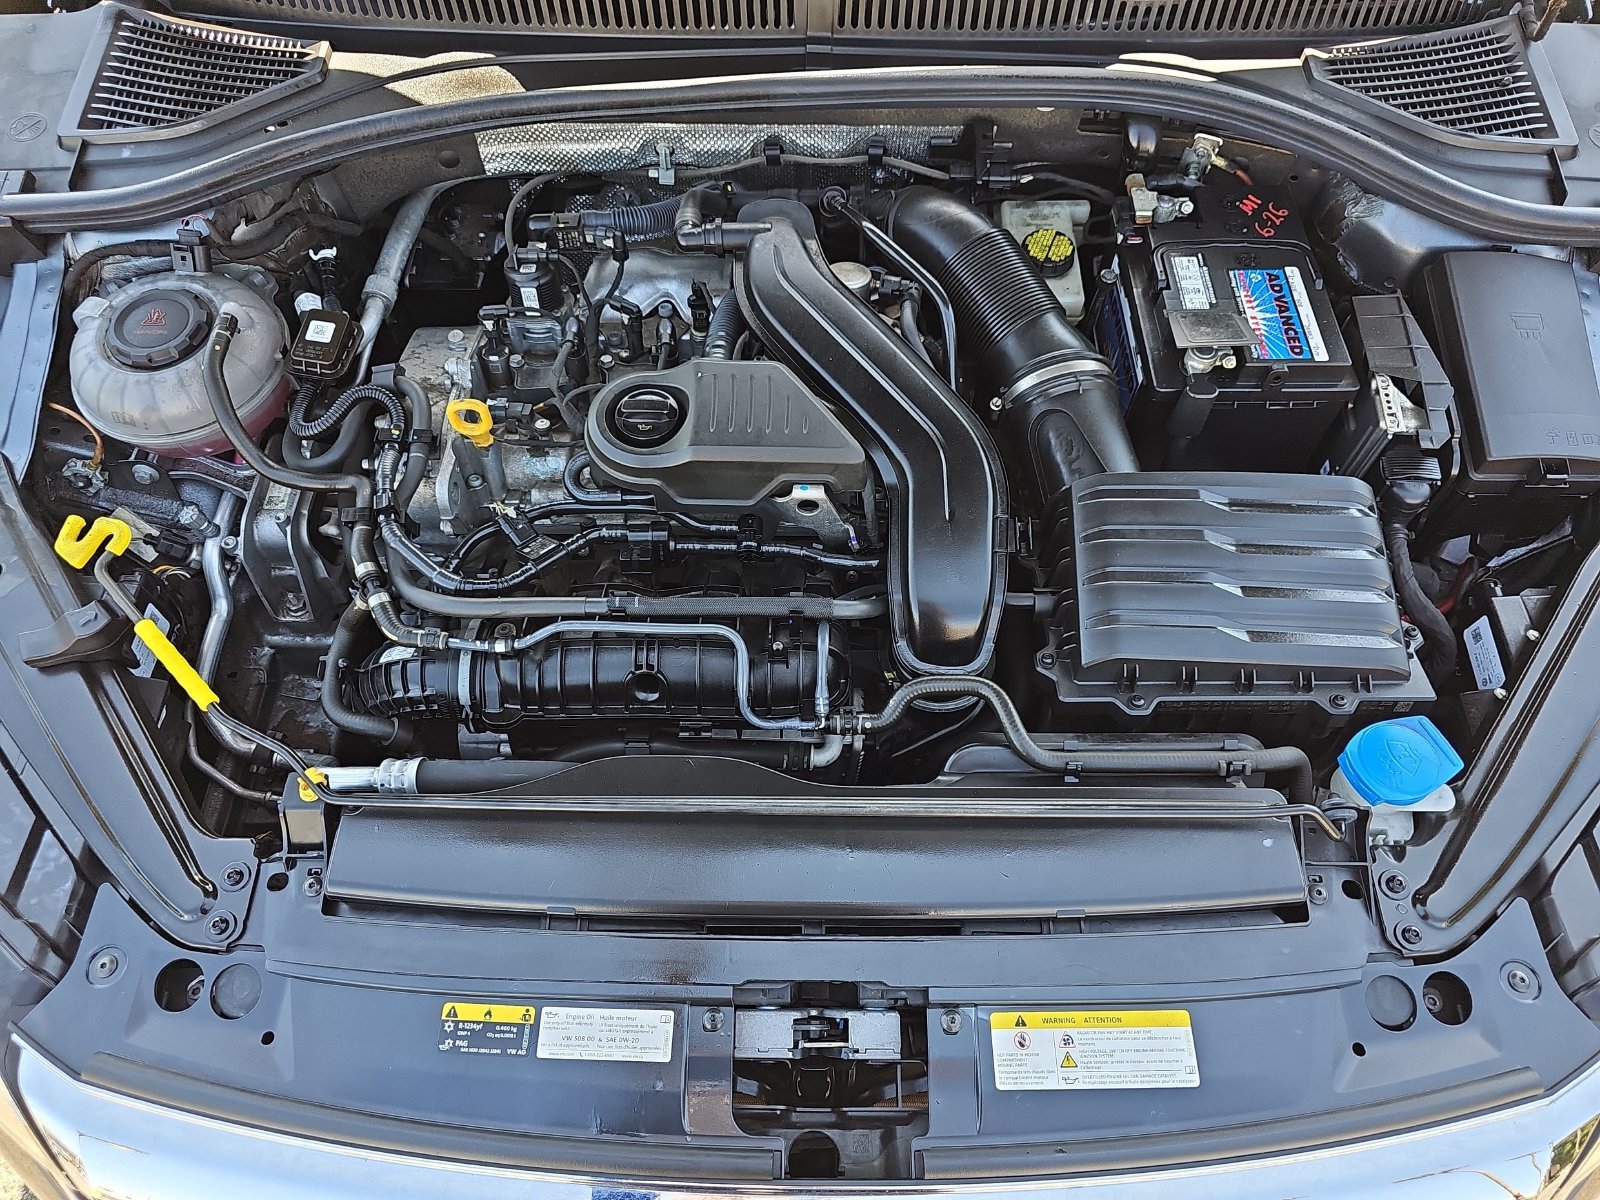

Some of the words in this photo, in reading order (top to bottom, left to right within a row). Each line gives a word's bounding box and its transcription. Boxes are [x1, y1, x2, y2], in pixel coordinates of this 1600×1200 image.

[1255, 201, 1289, 238] 6-26
[1237, 269, 1256, 311] BATTERY
[1265, 271, 1304, 357] ADVANCED
[458, 1022, 484, 1032] R-1234yf
[510, 1025, 518, 1033] kg
[565, 1013, 585, 1021] Engine
[1083, 1016, 1123, 1024] ATTENTION
